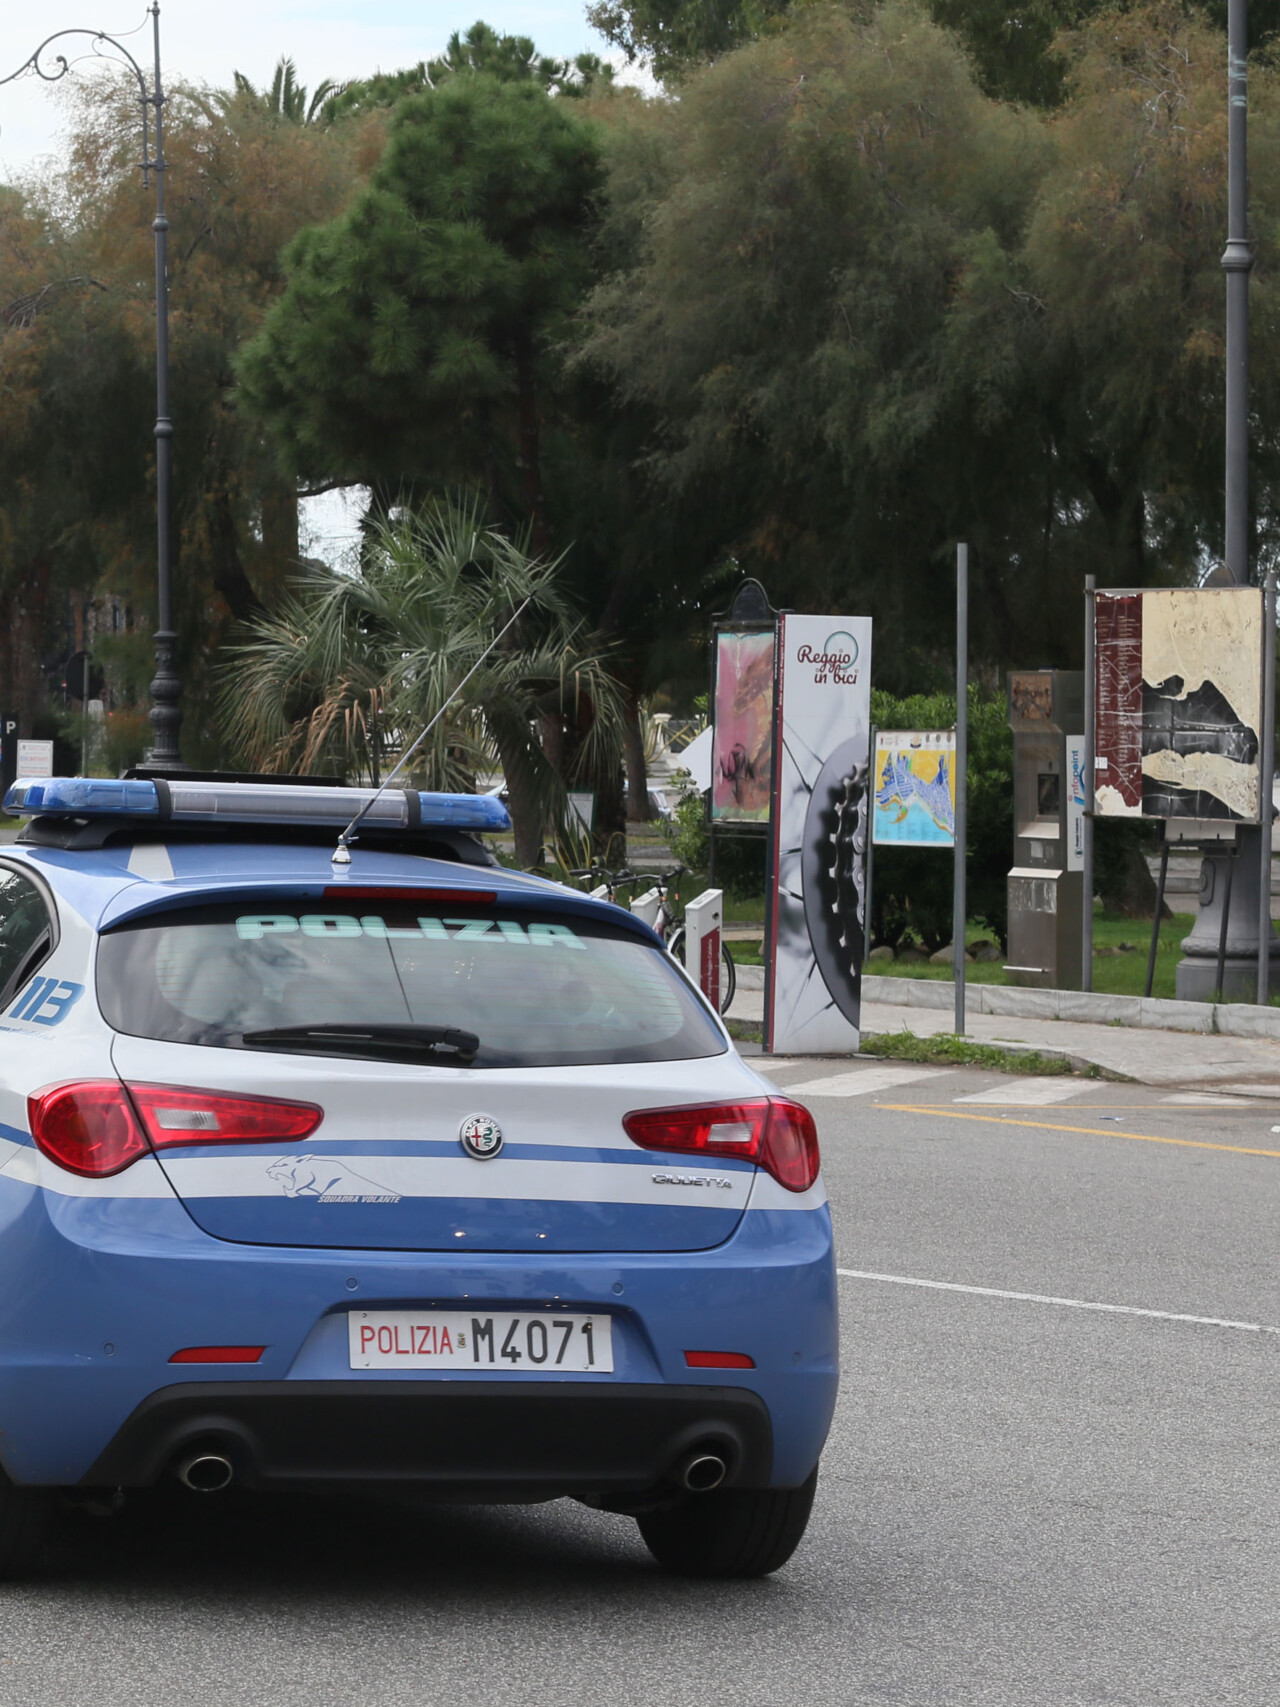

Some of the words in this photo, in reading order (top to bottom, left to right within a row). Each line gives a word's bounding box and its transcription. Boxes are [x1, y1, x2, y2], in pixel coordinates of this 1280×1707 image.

[797, 645, 851, 673] Reggio
[814, 668, 828, 684] in
[833, 663, 859, 685] bici
[6, 721, 16, 734] P
[235, 914, 588, 950] POLIZIA
[8, 976, 86, 1027] 113
[651, 1173, 733, 1189] GIULIETTA
[317, 1195, 360, 1204] SQUADRA
[361, 1195, 402, 1204] VOLANTE
[360, 1325, 454, 1355] POLIZIA
[471, 1318, 596, 1366] M4071
